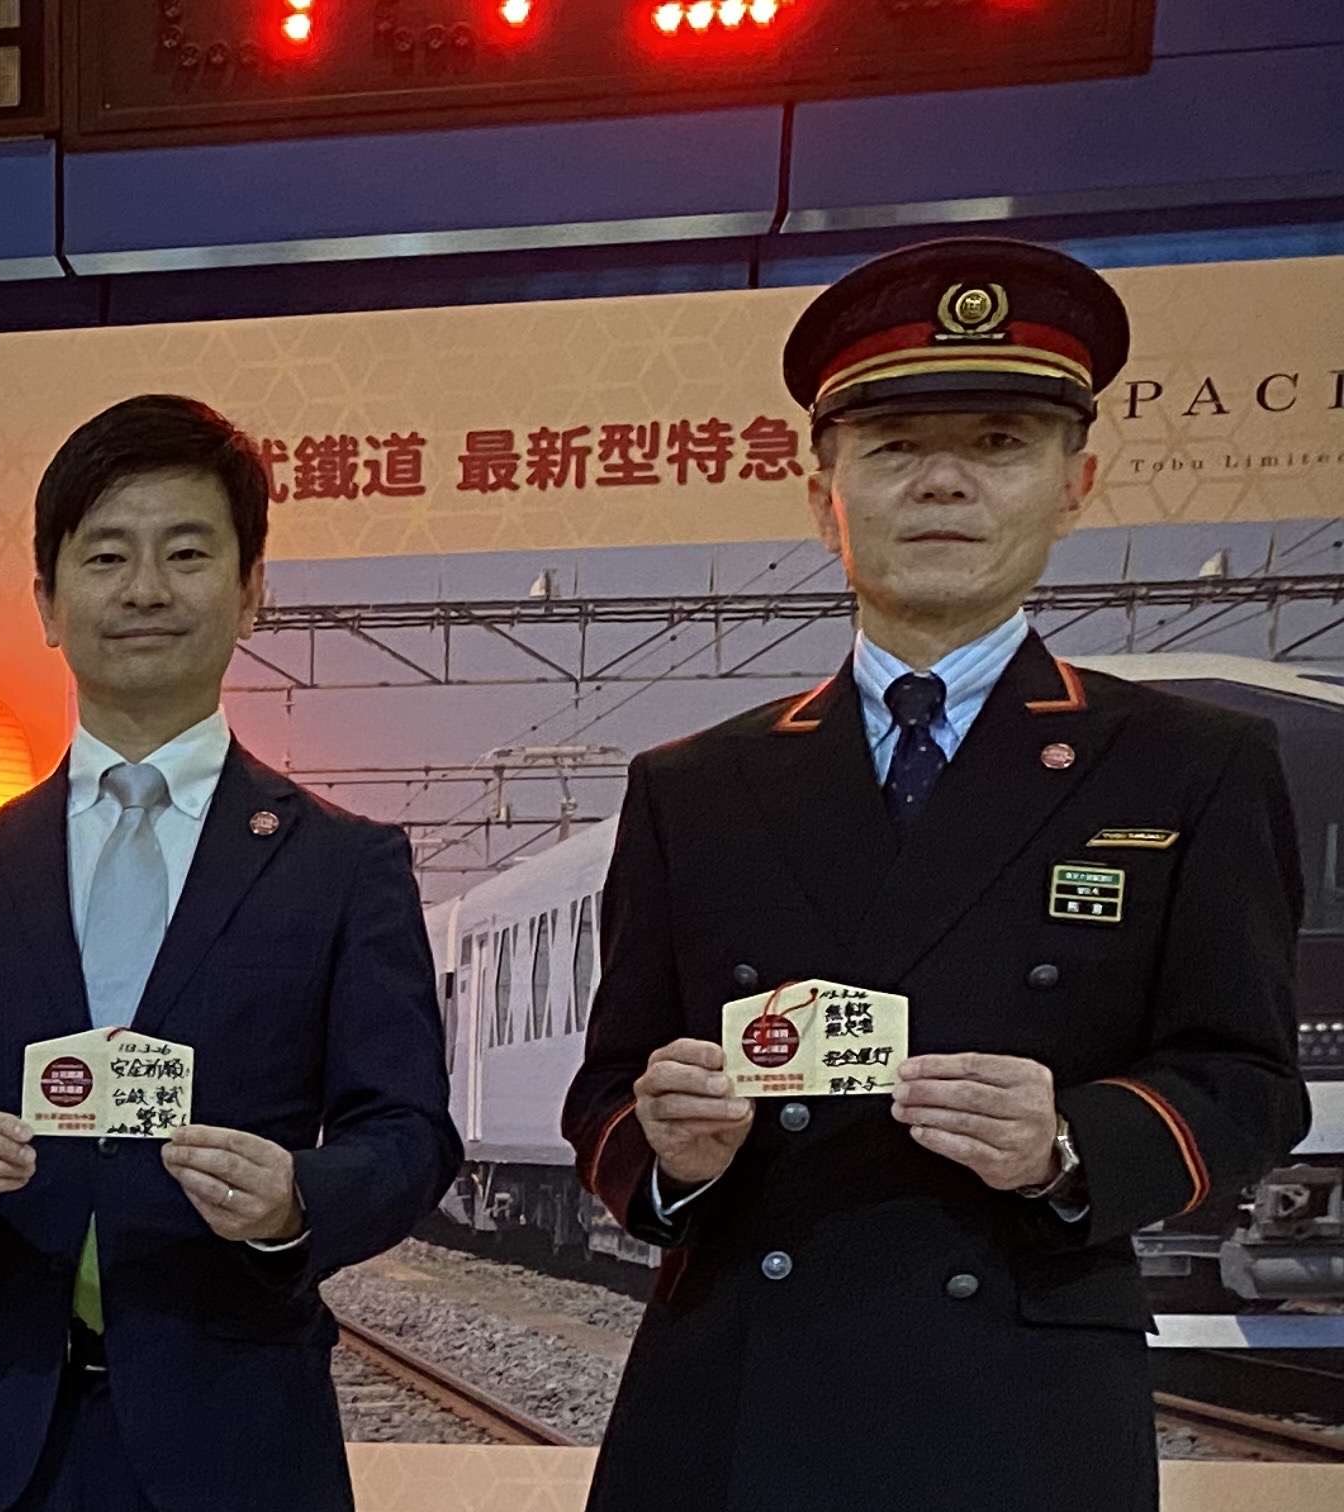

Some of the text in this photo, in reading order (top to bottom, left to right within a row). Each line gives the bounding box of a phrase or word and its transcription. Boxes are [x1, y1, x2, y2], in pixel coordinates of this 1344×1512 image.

[456, 416, 805, 495] 最新型特急
[1130, 458, 1205, 474] Tobu
